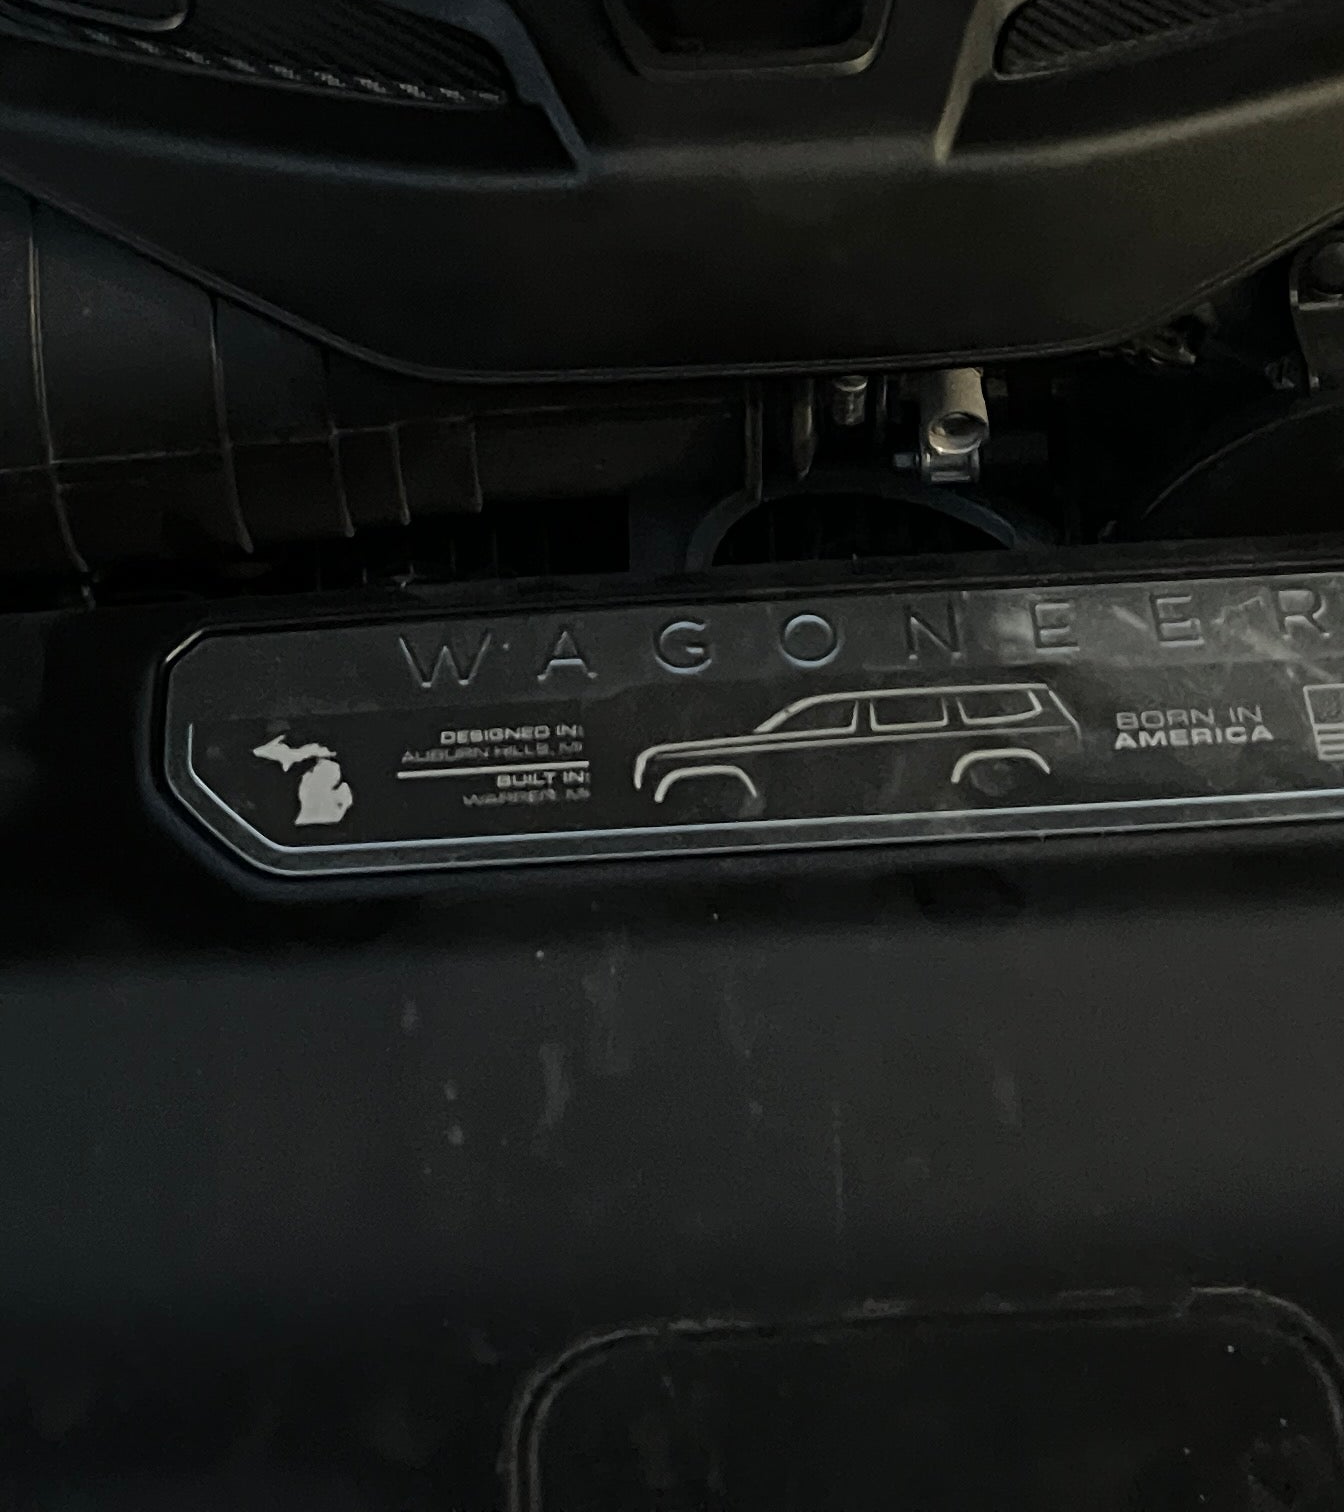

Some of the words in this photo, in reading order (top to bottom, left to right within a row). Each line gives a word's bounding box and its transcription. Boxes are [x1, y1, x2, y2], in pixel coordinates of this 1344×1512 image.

[397, 586, 1333, 689] WAGONEER
[1115, 707, 1216, 731] BORN
[1229, 703, 1264, 724] IN
[440, 724, 551, 745] DESIGNED
[1114, 724, 1275, 751] AMERICA
[496, 770, 557, 789] BUILT
